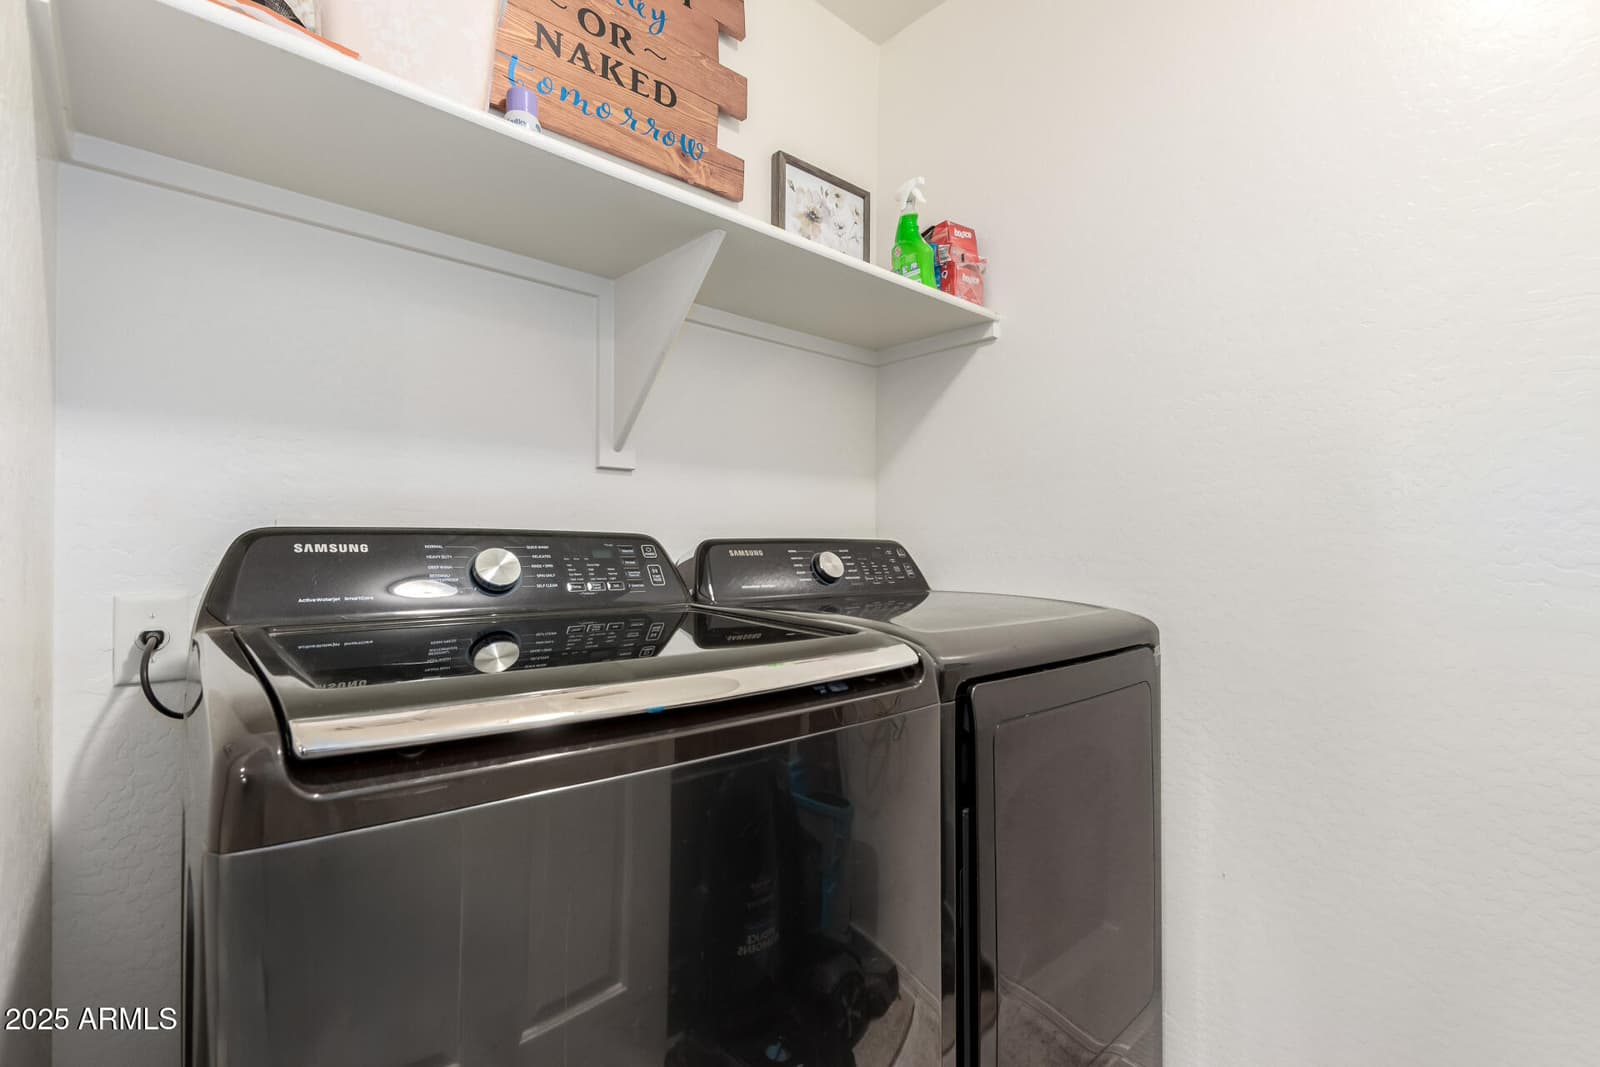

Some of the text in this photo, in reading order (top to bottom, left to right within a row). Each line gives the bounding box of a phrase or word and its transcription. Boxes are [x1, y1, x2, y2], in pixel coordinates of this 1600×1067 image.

[577, 7, 635, 55] OR
[534, 21, 677, 108] NAKED
[293, 543, 369, 553] SAMSUNG
[728, 549, 764, 557] SAMSUNG
